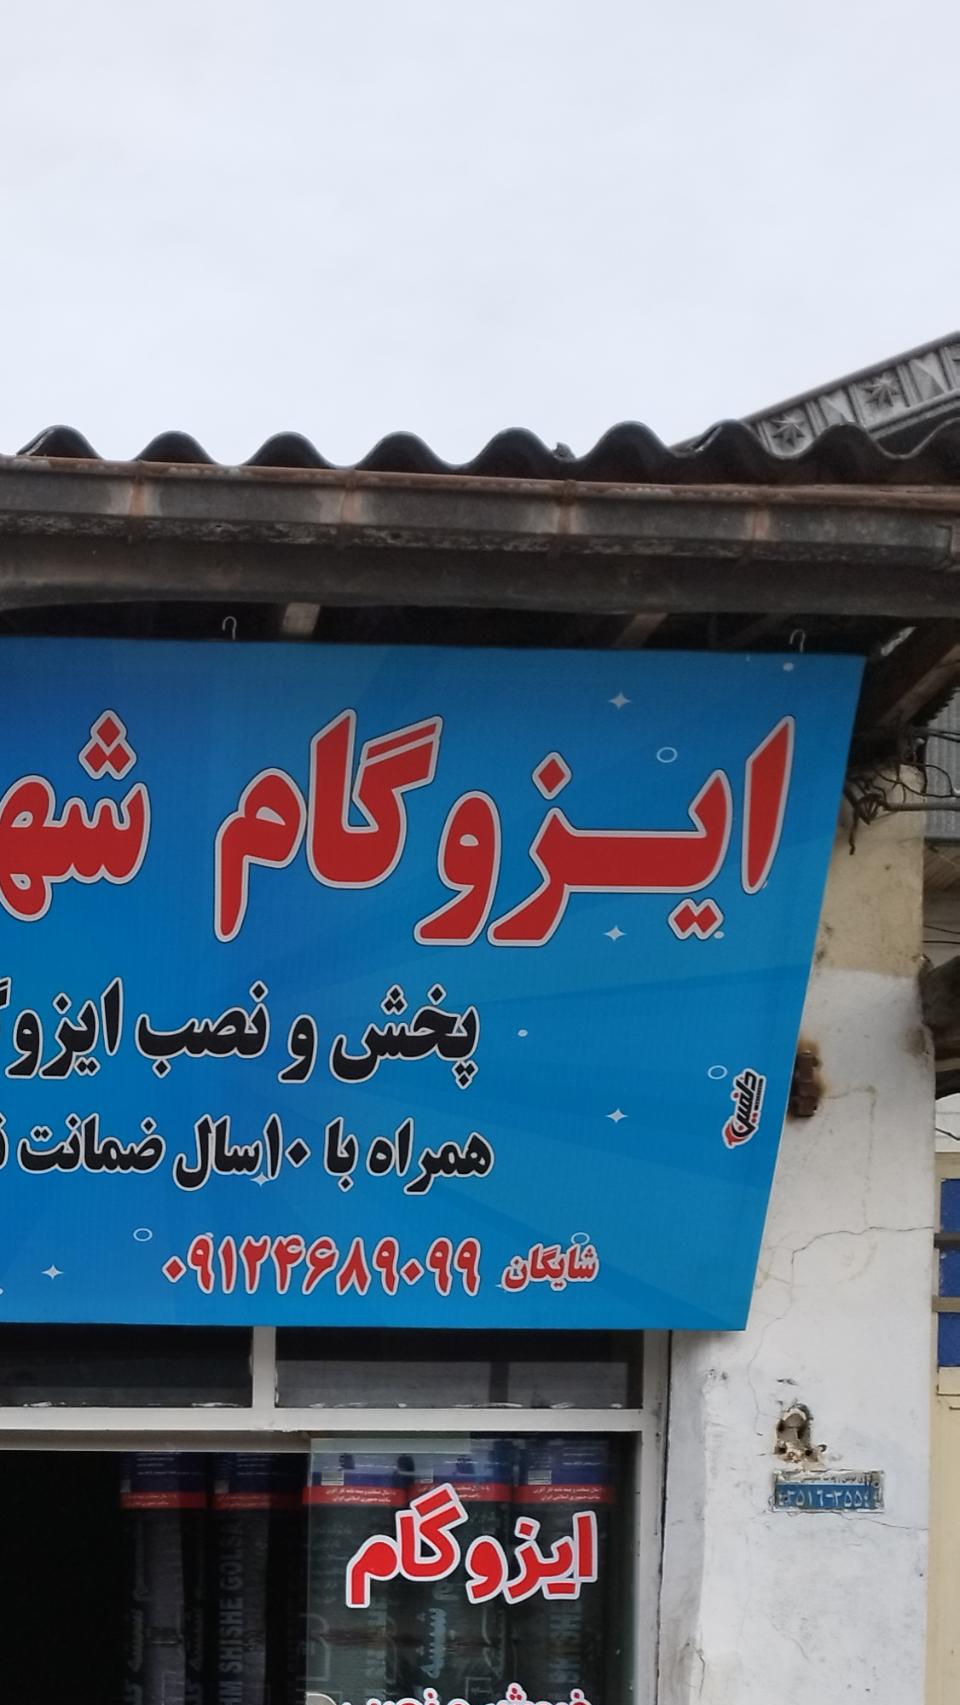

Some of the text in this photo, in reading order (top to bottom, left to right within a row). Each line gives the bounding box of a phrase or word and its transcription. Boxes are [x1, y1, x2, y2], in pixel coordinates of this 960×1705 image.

[214, 709, 796, 947] ایزوگام
[135, 980, 269, 1078] نصب
[278, 1014, 317, 1083] و
[330, 983, 480, 1089] پخش
[17, 1113, 166, 1173] ضمانت
[325, 1117, 358, 1191] با
[366, 1117, 494, 1195] همراه
[162, 1233, 599, 1296] شایگان ۰۹۱۲۴۶۸۹۰۹۹
[346, 1483, 598, 1608] ایزوگام
